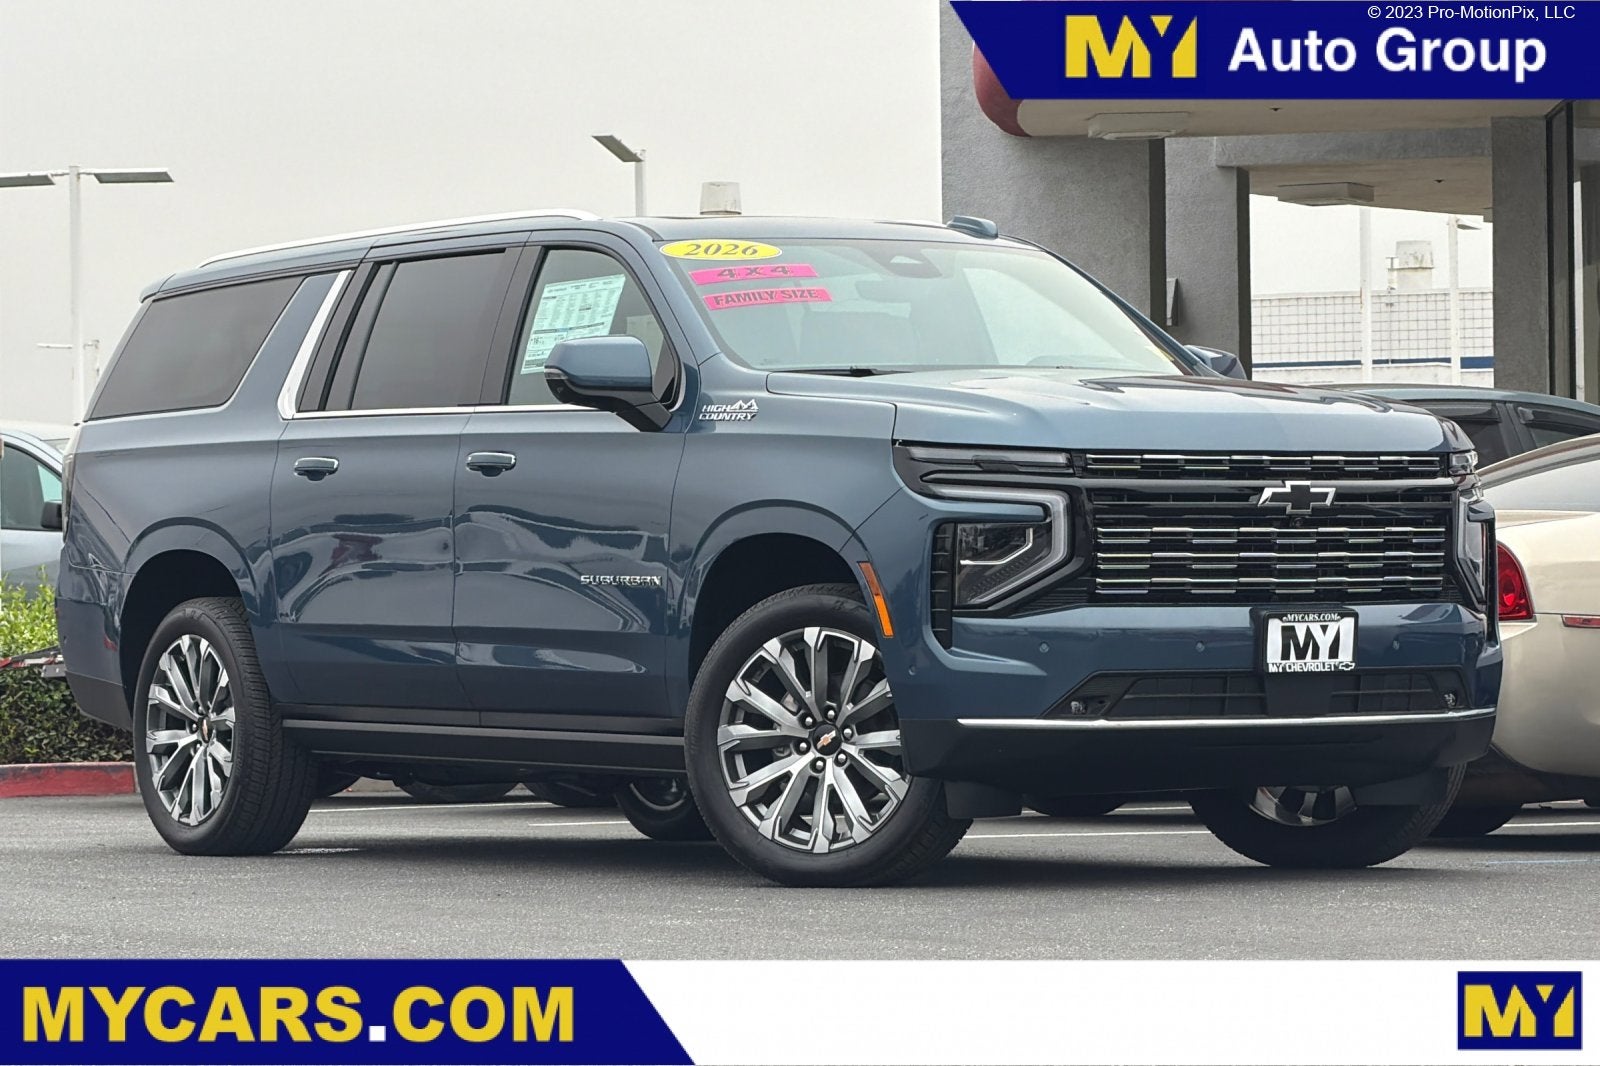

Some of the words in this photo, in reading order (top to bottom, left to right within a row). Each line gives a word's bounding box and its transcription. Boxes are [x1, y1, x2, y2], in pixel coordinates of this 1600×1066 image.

[684, 243, 758, 256] 2026
[713, 290, 777, 306] FAMILY
[780, 289, 819, 299] SIZE
[702, 404, 731, 412] HIGH
[699, 413, 757, 421] COUNTRY
[580, 575, 662, 586] SUBURBAN
[1287, 613, 1338, 622] MYCARS.COM
[1280, 624, 1340, 661] MY
[1268, 663, 1282, 673] MY
[1286, 662, 1335, 672] CHEVROLET
